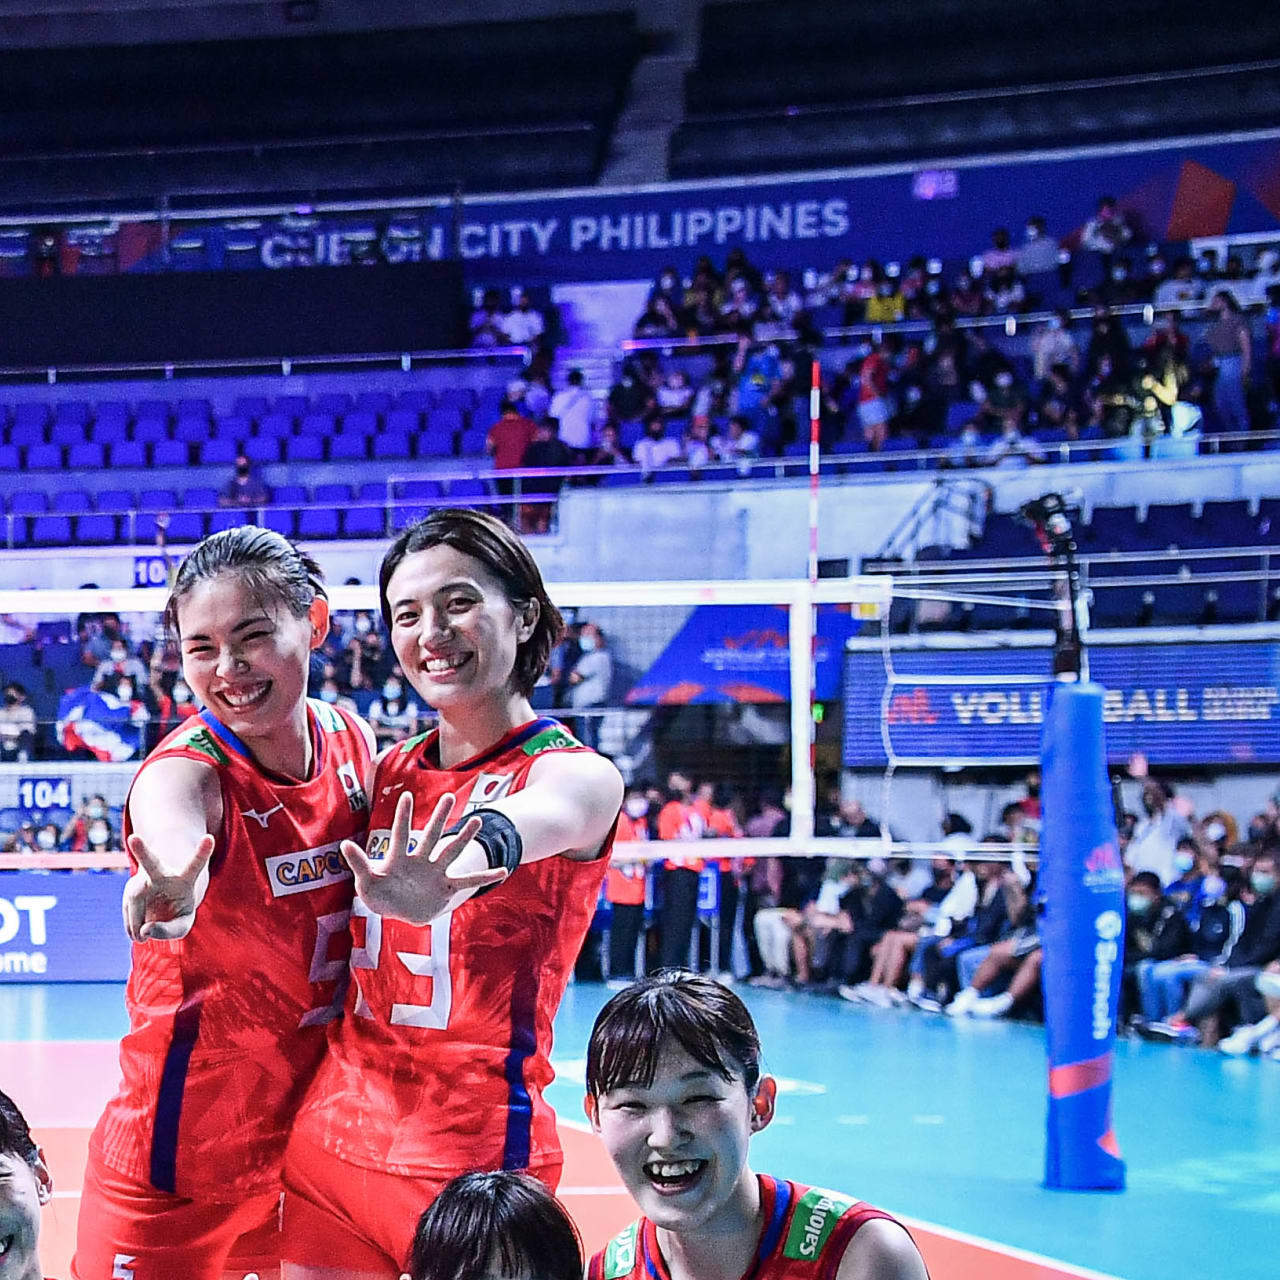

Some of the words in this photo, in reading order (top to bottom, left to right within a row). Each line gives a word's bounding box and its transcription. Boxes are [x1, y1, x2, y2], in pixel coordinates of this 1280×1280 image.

[460, 218, 558, 259] CITY
[571, 201, 848, 252] PHILIPPINES
[22, 781, 71, 808] 104
